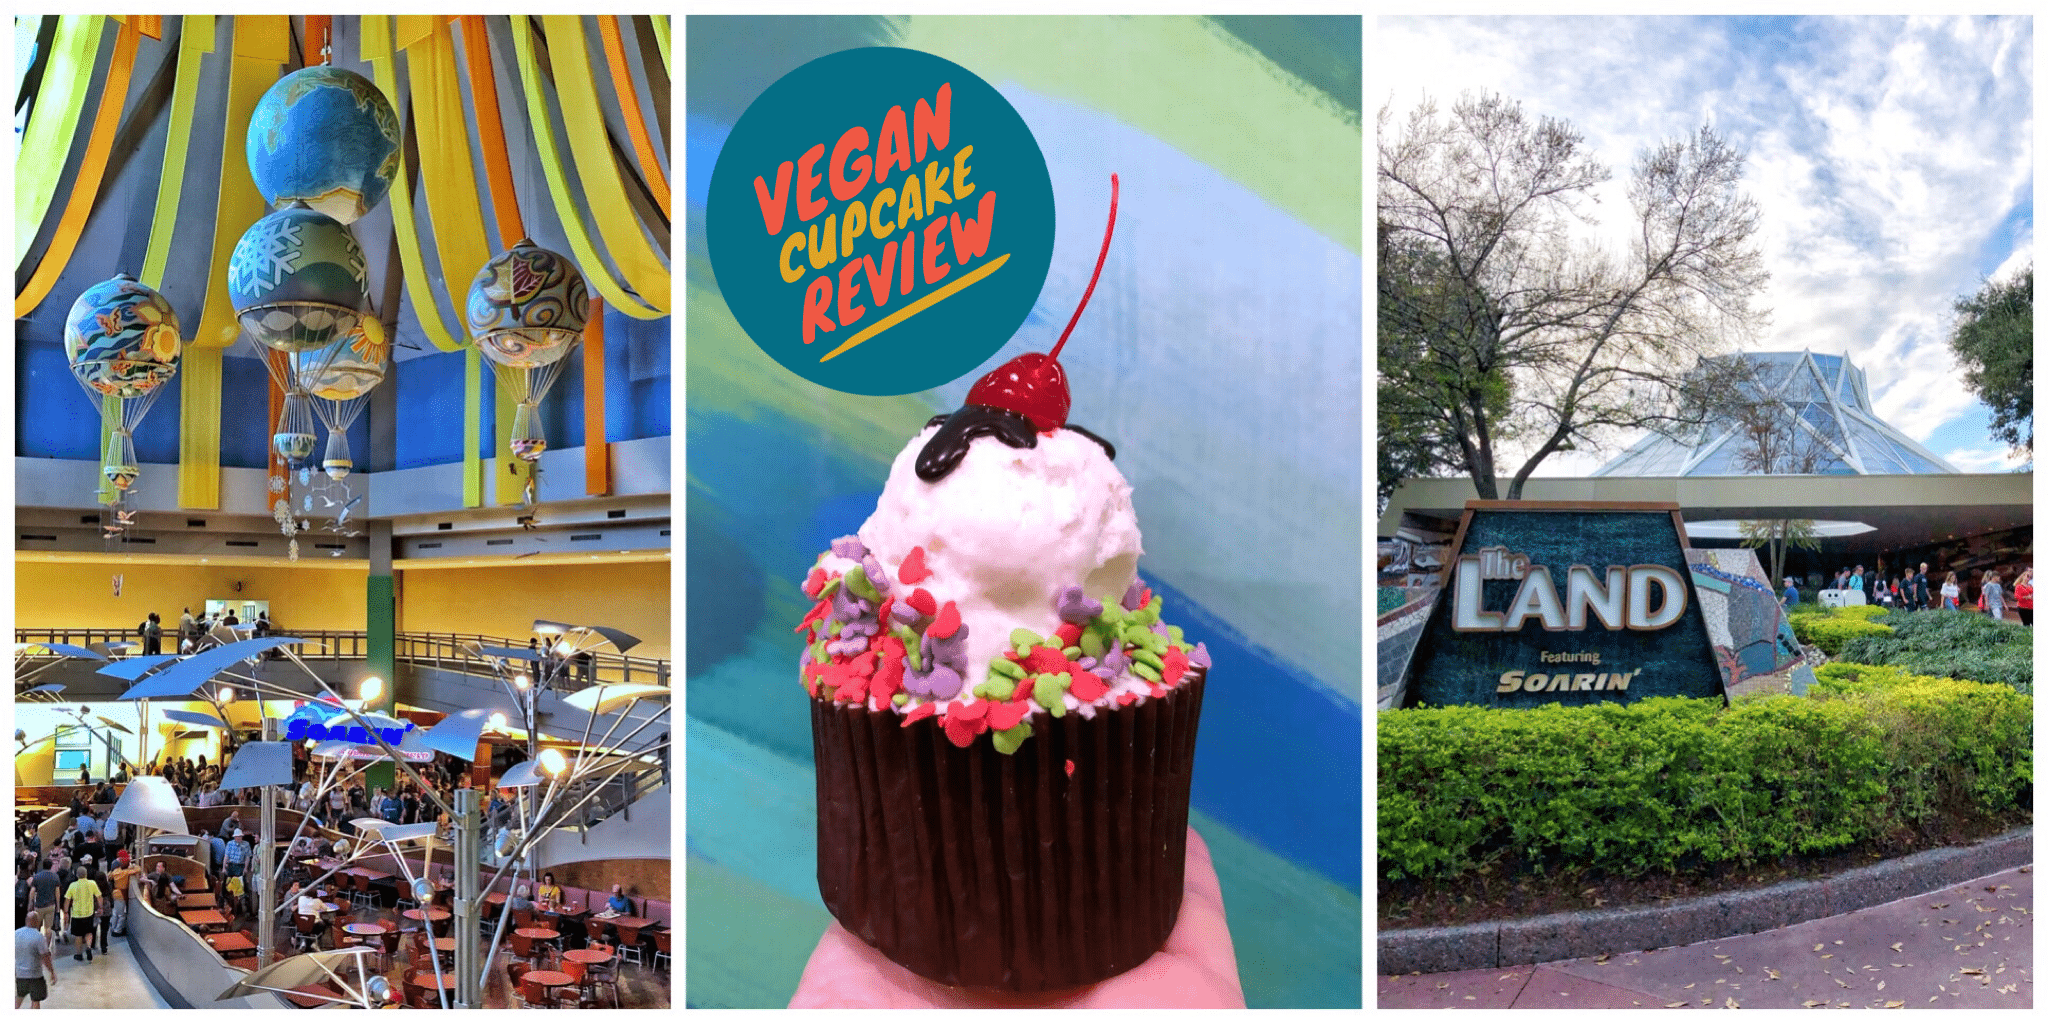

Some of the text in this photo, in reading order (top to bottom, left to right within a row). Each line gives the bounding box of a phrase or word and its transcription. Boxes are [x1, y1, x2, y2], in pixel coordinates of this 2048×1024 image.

[1481, 548, 1527, 579] The
[1453, 554, 1688, 632] LAND
[1540, 650, 1601, 665] Featuring
